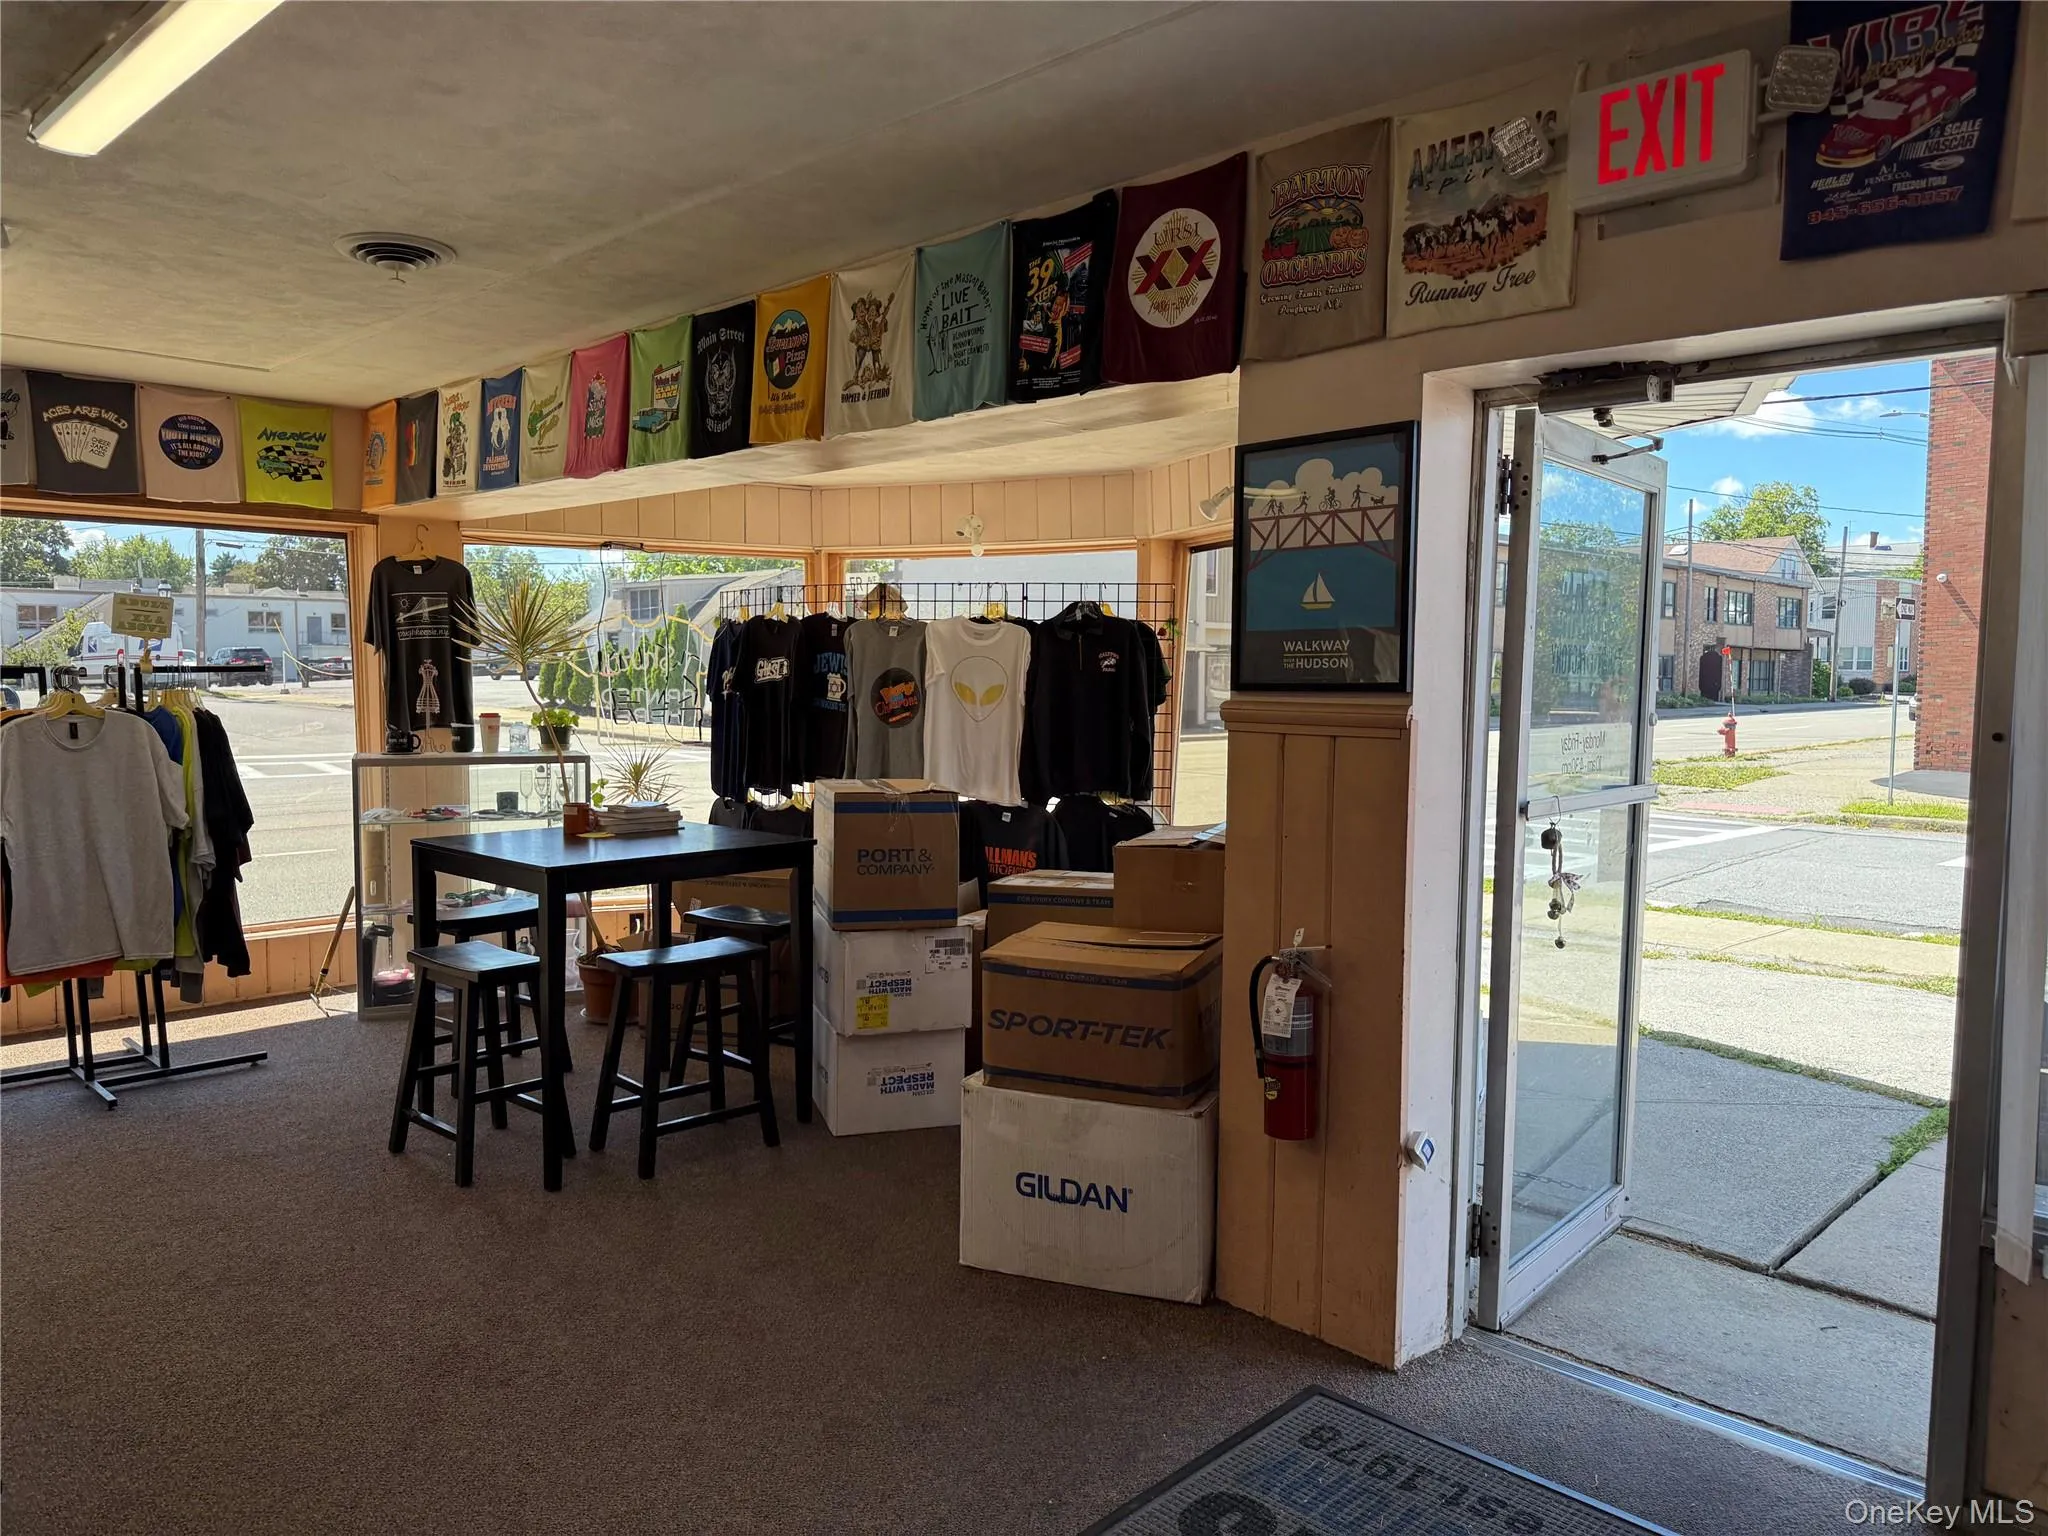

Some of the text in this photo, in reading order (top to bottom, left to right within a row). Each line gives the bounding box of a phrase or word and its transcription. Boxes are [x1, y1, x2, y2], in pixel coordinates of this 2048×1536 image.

[1598, 63, 1726, 185] EXIT
[1944, 118, 1983, 136] SCALE
[1922, 132, 1979, 156] NASCAR
[1269, 164, 1372, 219] BARTON
[1260, 243, 1368, 290] ORCHARDS
[1027, 258, 1055, 297] 39
[1405, 263, 1537, 306] Running Free
[942, 286, 971, 311] LIVE
[1034, 281, 1058, 303] STEPS
[942, 303, 979, 329] BAIT
[697, 327, 745, 354] Main Street
[786, 350, 806, 363] Pizza
[42, 405, 129, 429] ACES ARE WILD
[706, 416, 732, 432] Bistro
[161, 428, 221, 448] YOUTH HOCKEY
[178, 449, 188, 457] THE
[193, 443, 213, 454] ABOUT
[1283, 639, 1350, 652] WALKWAY
[1296, 657, 1348, 669] HUDSON
[857, 849, 933, 863] PORT &
[857, 864, 931, 875] COMPANY
[868, 987, 889, 995] WITH
[869, 978, 912, 988] RESPECT
[988, 1009, 1173, 1050] SPORT-TEK
[880, 1071, 934, 1086] RESPECT
[880, 1082, 934, 1094] MADE WITH
[1015, 1172, 1128, 1213] GILDAN
